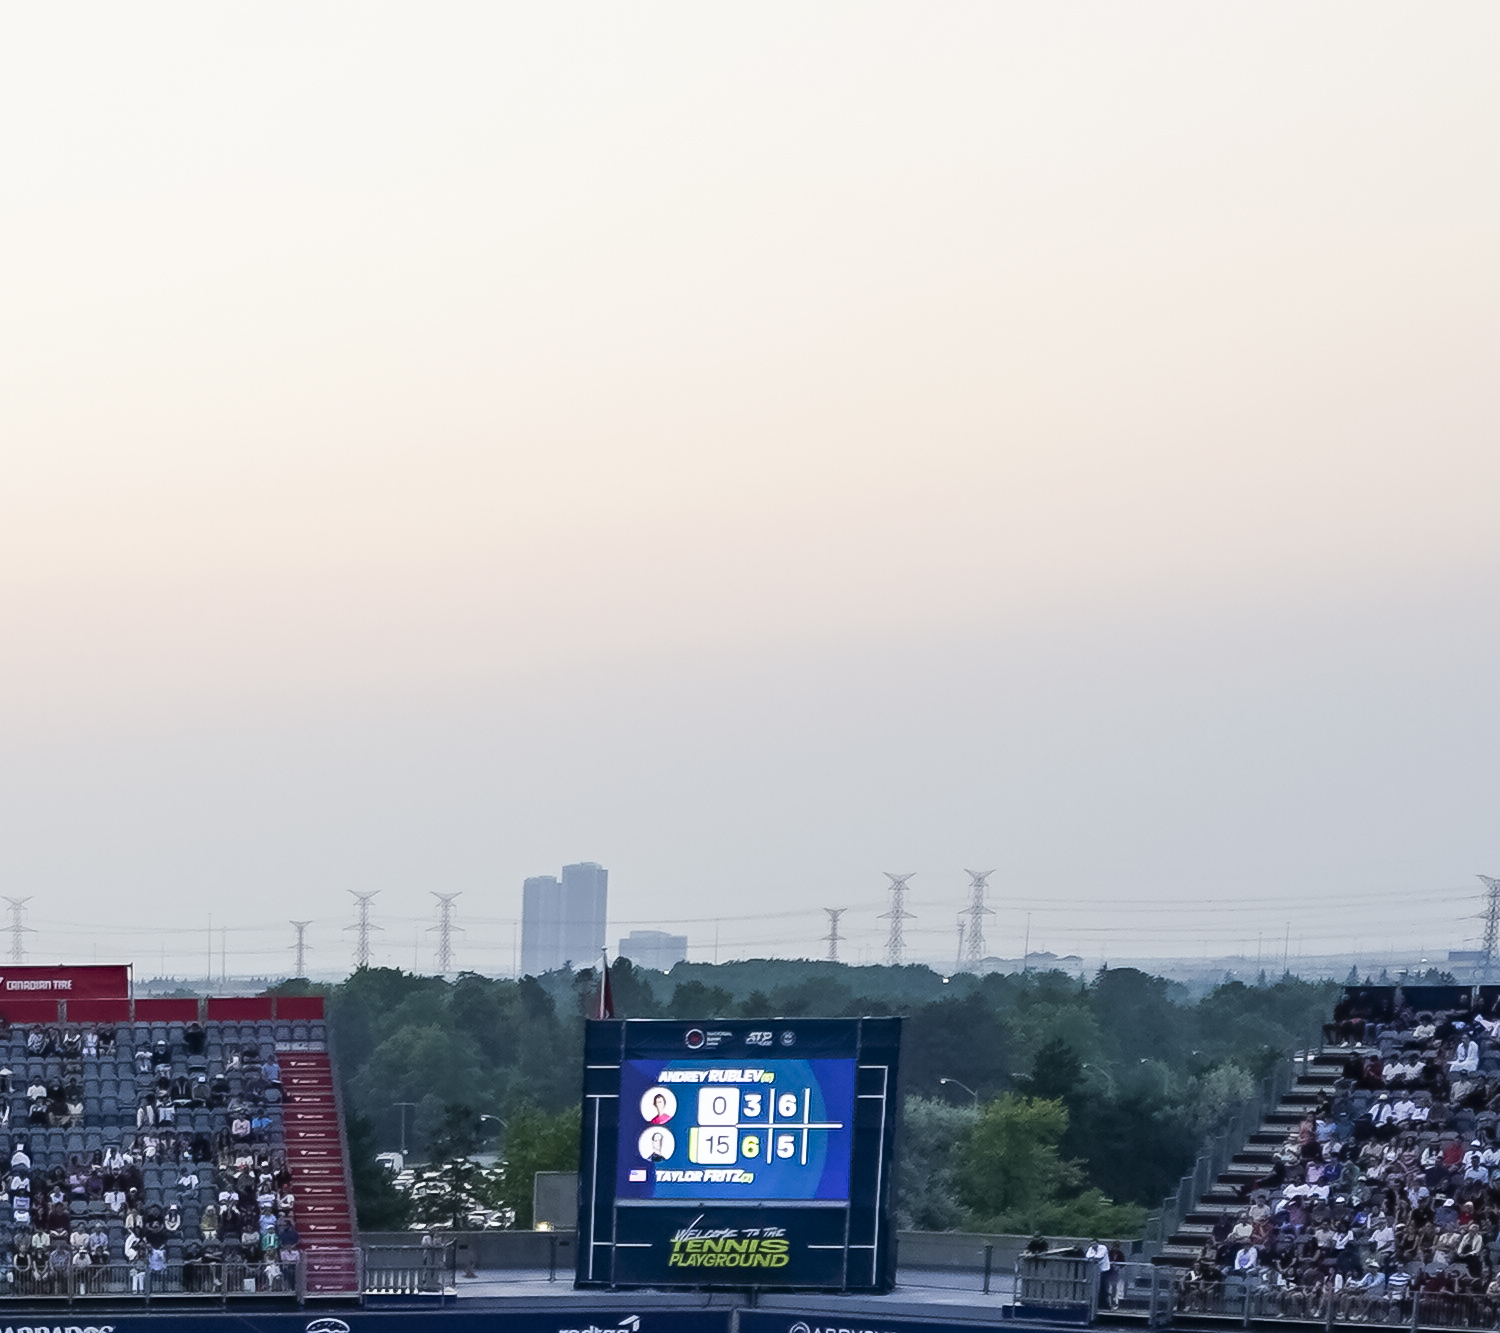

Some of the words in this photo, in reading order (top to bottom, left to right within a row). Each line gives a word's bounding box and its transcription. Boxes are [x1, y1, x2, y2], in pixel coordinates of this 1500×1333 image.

[5, 979, 51, 991] CANADIAN
[52, 980, 73, 990] TIRE
[707, 1069, 763, 1083] RUBLEV
[713, 1095, 726, 1116] 0
[742, 1093, 762, 1118] 3
[778, 1093, 797, 1118] 6
[706, 1135, 730, 1155] 15
[741, 1135, 760, 1158] 6
[776, 1134, 795, 1159] 5
[655, 1169, 704, 1183] TAYLOR
[702, 1169, 745, 1183] FRITZ
[675, 1239, 790, 1253] TENNIS
[668, 1253, 790, 1268] PLAYGROUND
